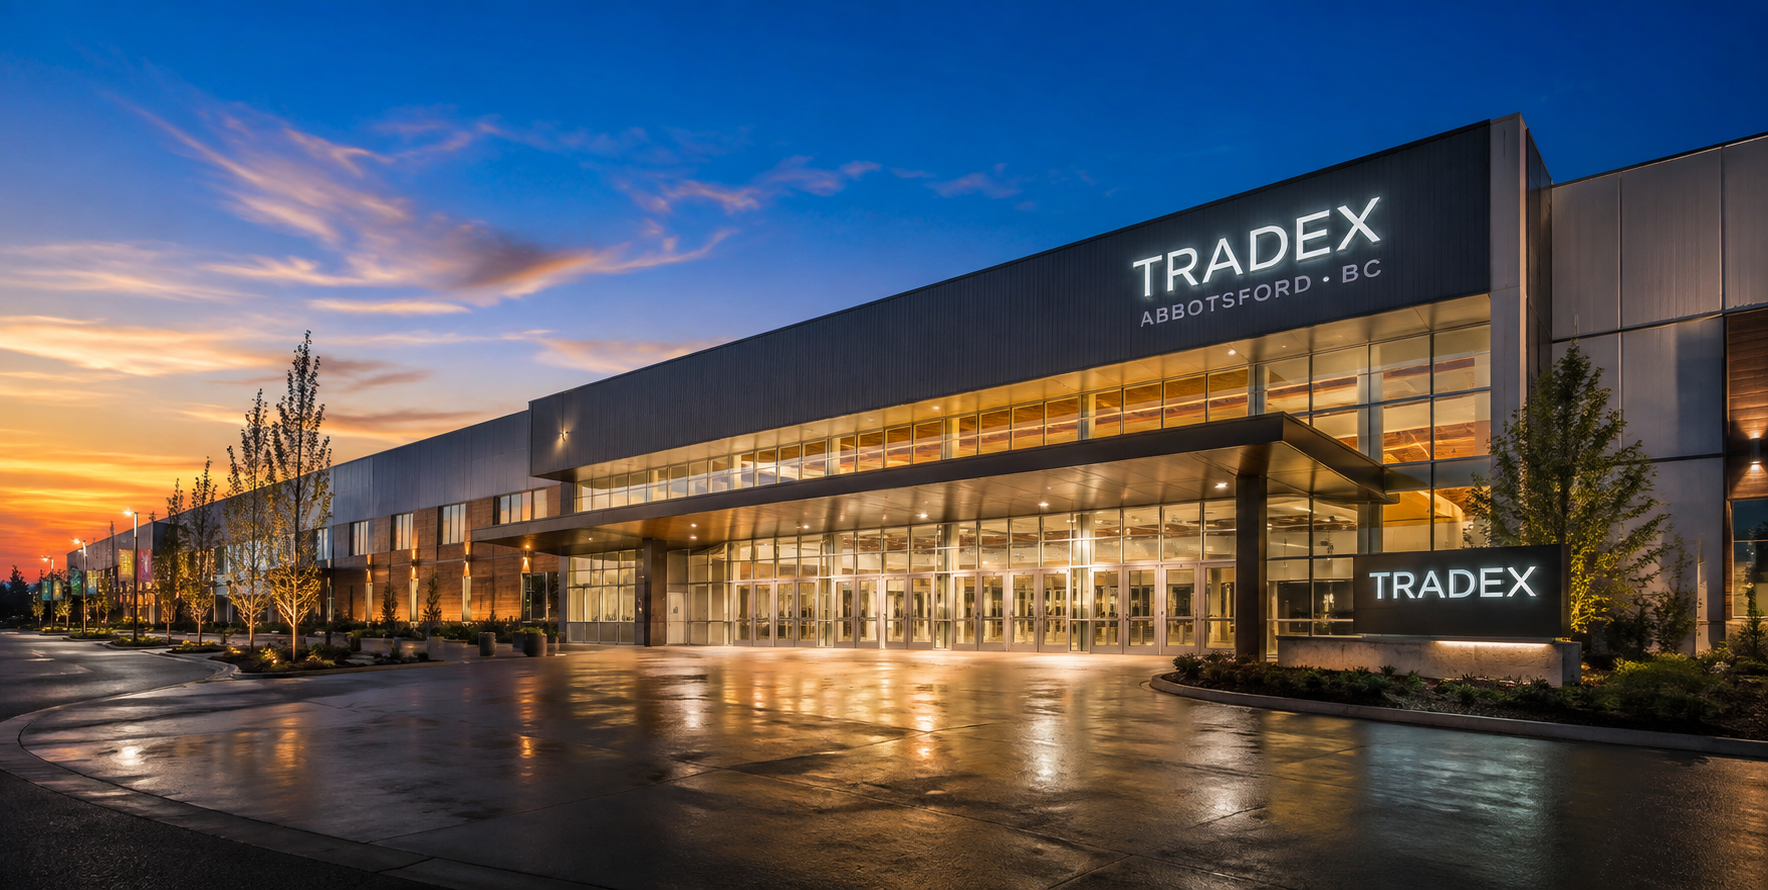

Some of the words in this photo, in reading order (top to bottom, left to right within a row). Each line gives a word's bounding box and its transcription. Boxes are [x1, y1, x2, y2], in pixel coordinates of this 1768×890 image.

[1132, 196, 1381, 297] TRADEX
[1140, 275, 1312, 328] ABBOTSFORD
[1341, 259, 1382, 284] BC
[1369, 566, 1537, 600] TRADEX
